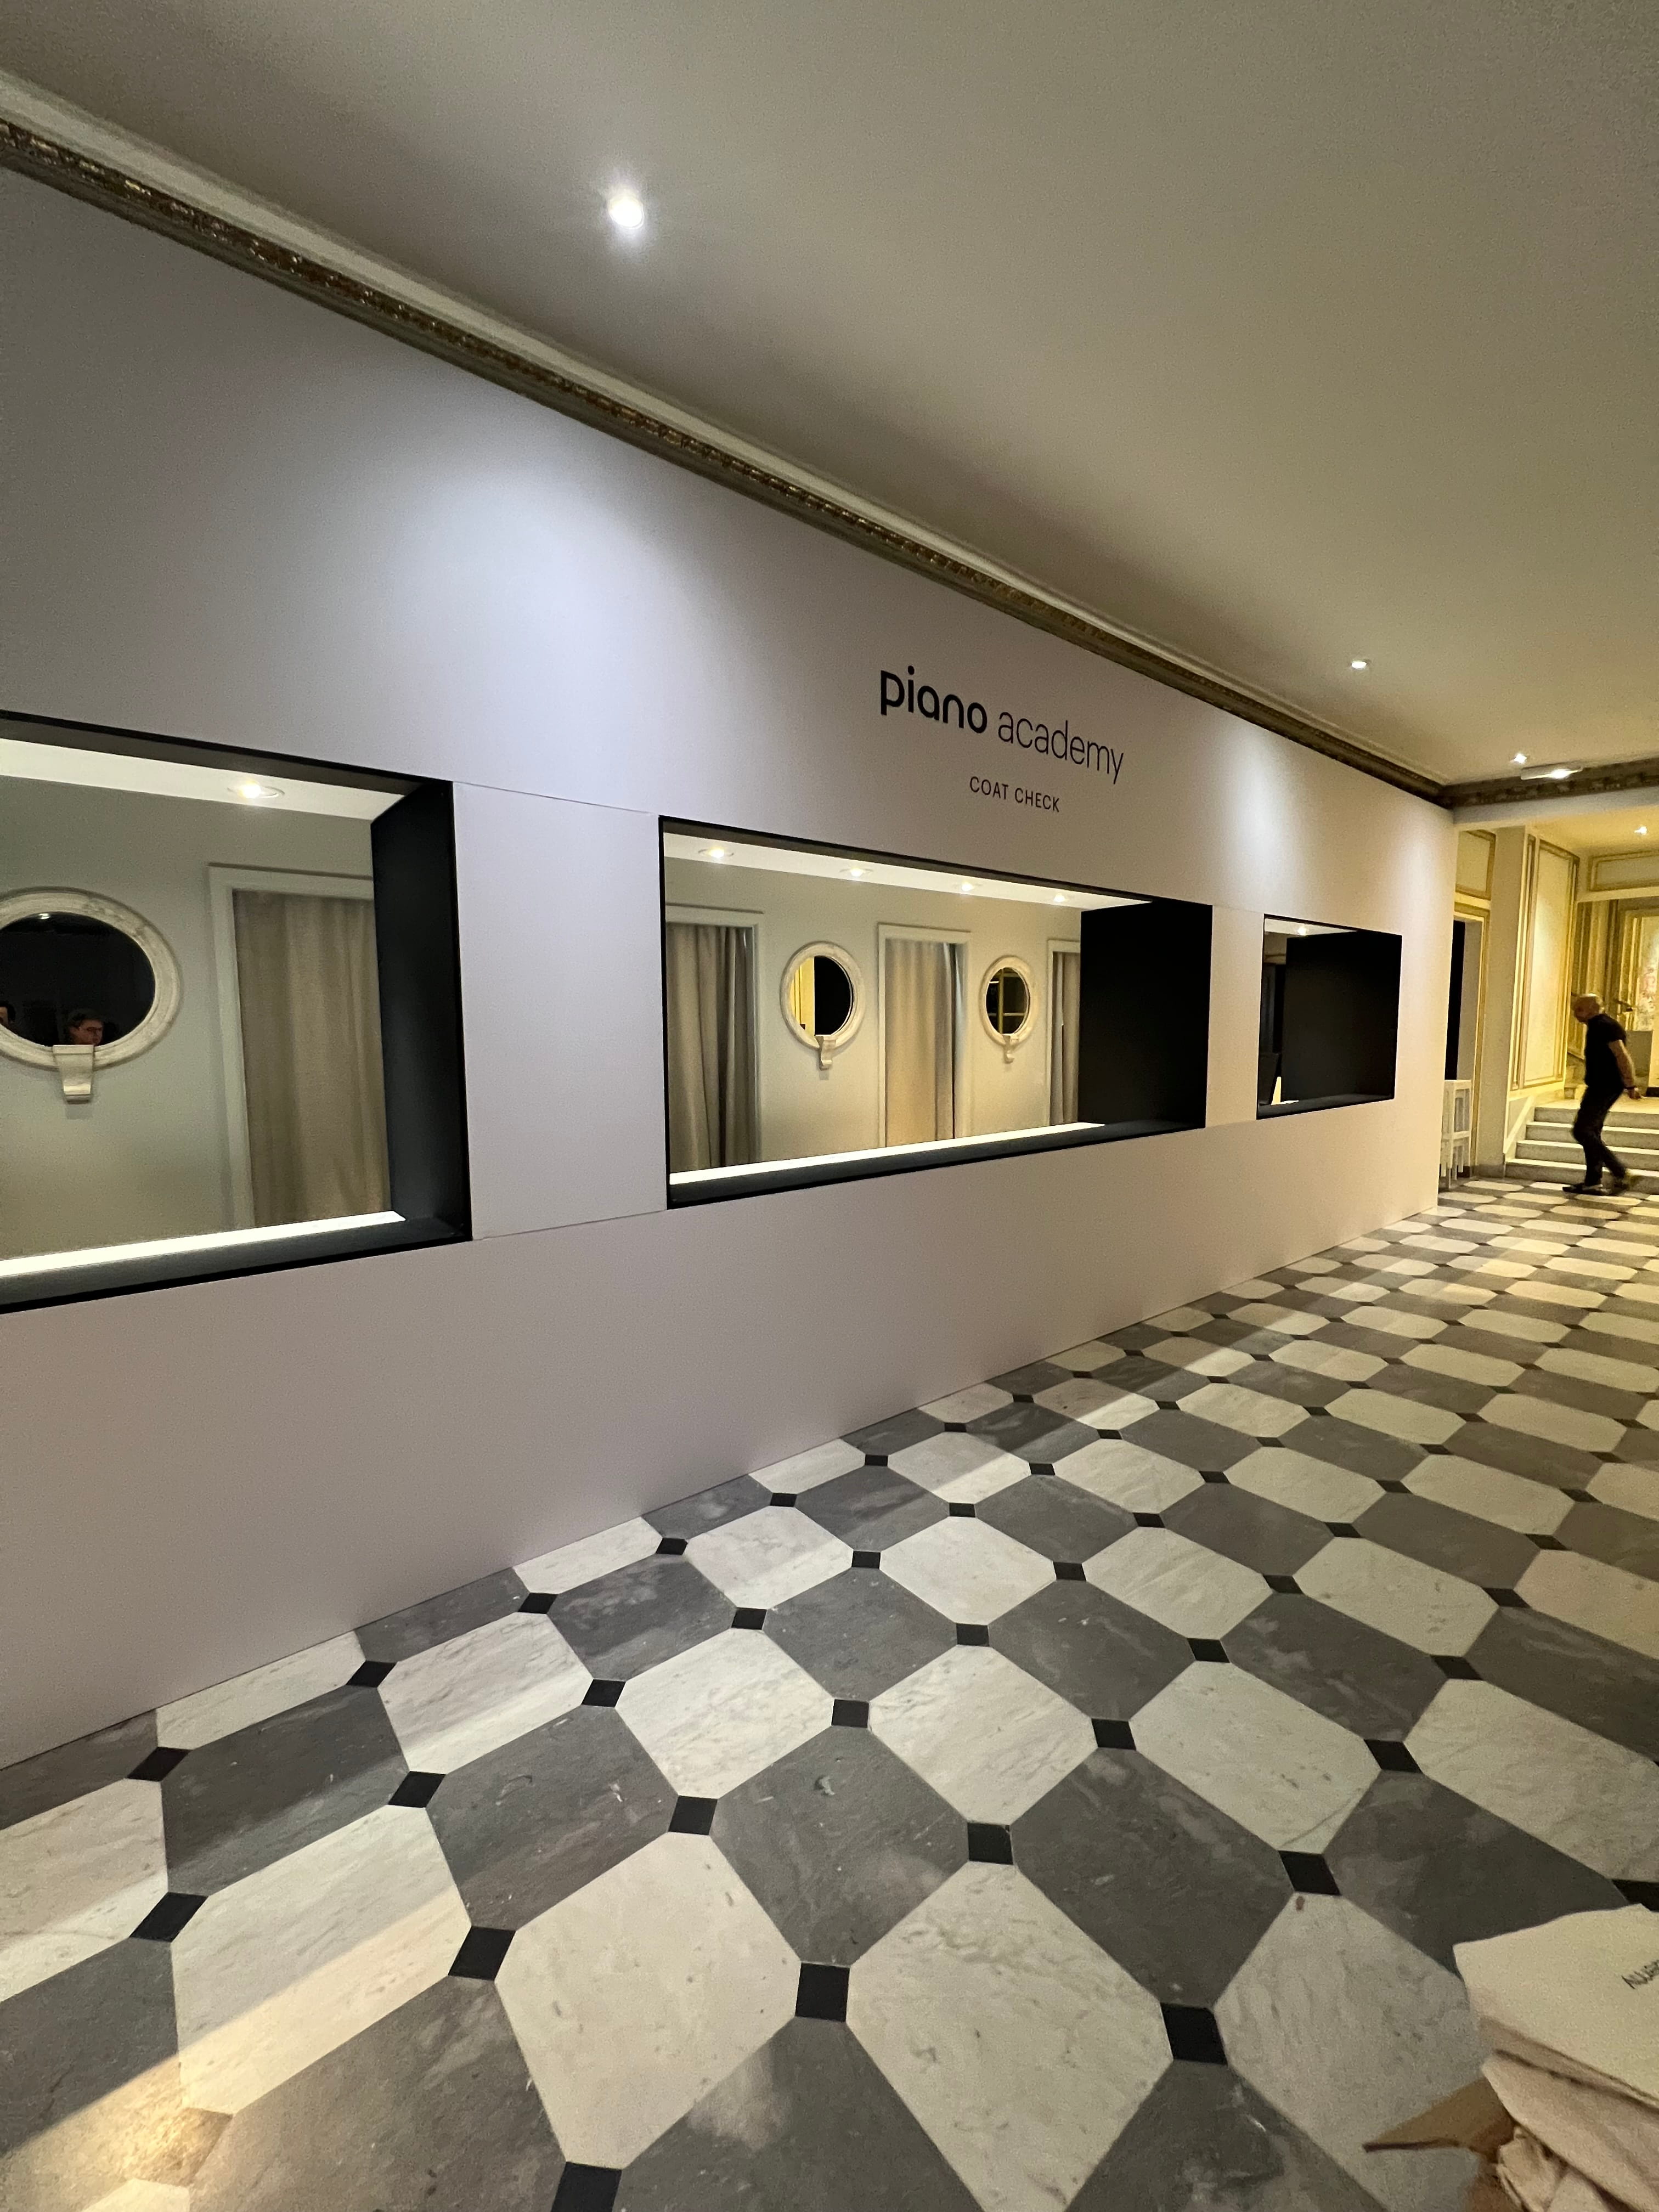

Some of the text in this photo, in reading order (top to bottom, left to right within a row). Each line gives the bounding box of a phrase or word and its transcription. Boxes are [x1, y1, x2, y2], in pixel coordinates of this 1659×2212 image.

[881, 665, 1124, 785] piano academy
[969, 776, 1059, 813] COAT CHECK
